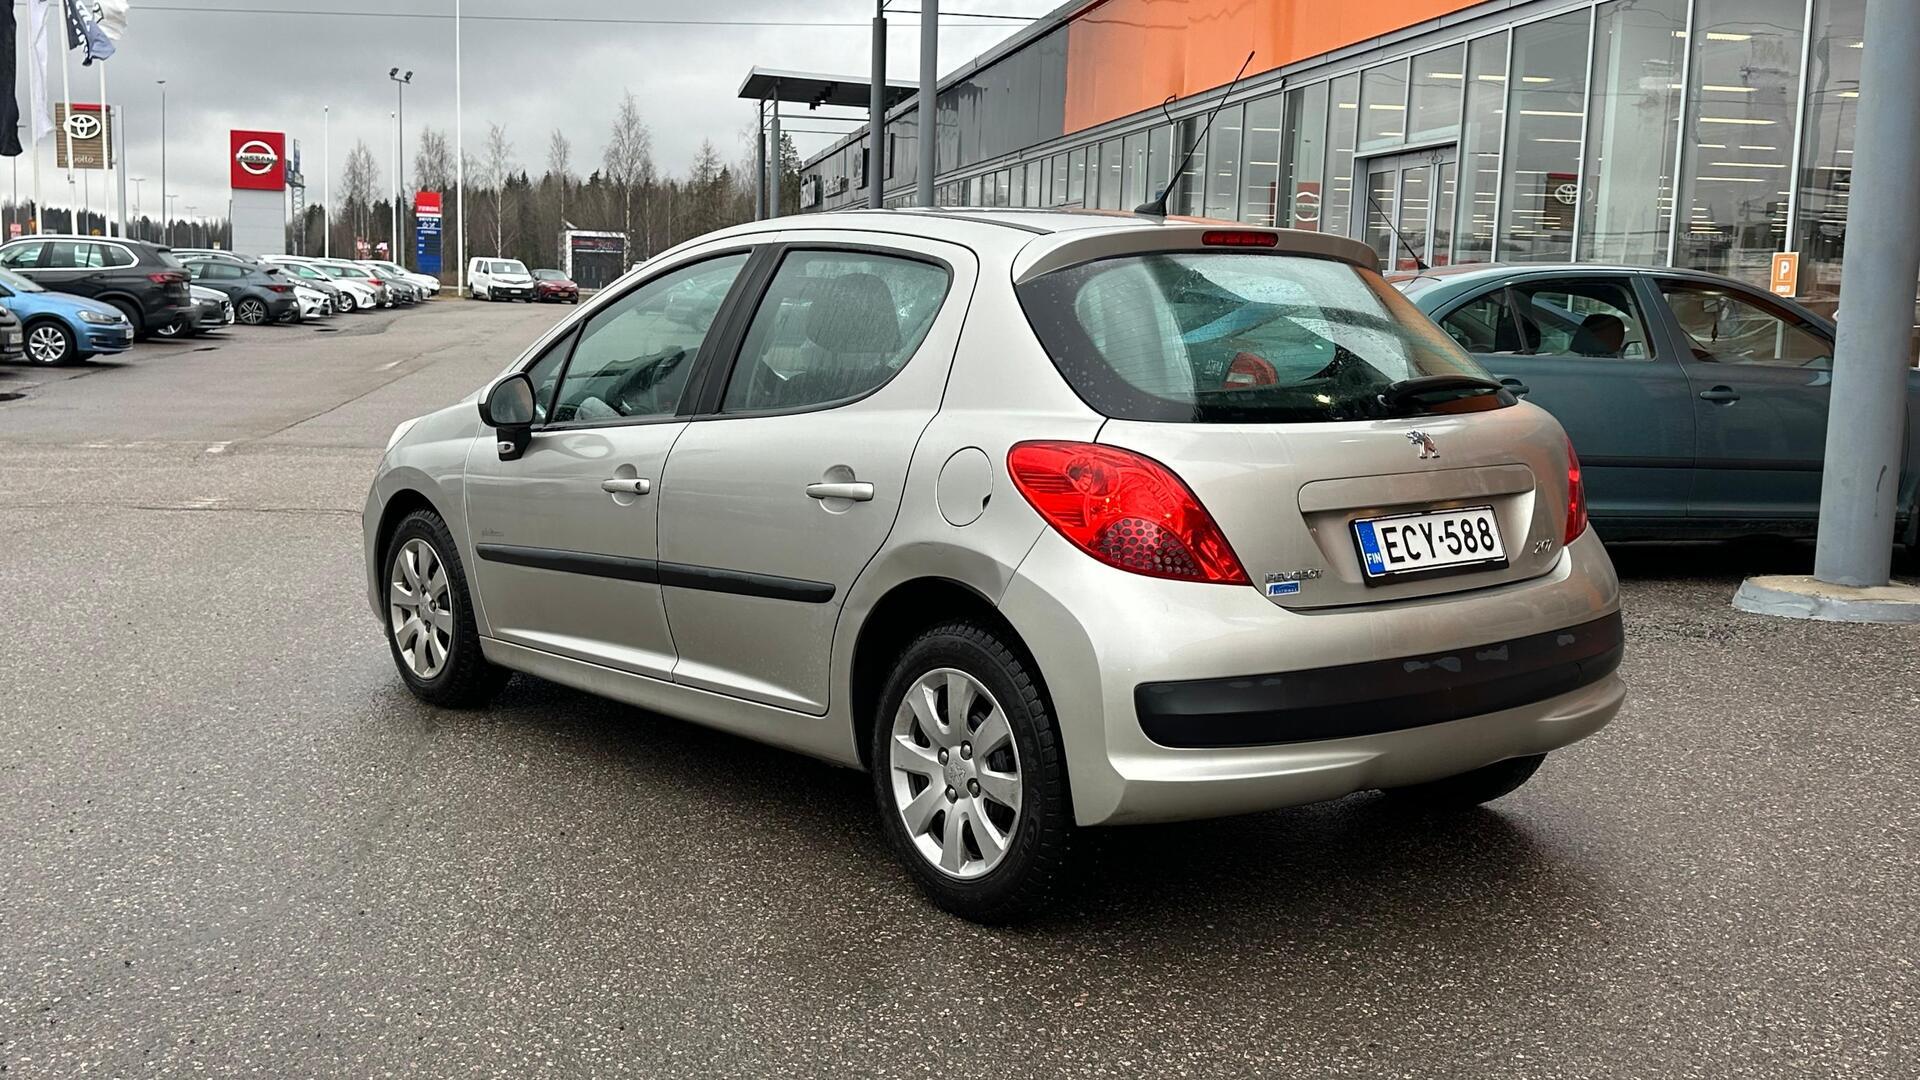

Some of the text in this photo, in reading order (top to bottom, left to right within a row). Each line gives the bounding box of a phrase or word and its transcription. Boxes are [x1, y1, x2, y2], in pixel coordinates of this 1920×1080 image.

[1780, 261, 1790, 280] P
[1381, 517, 1495, 563] ECY-588
[1366, 552, 1383, 565] FIN
[1265, 569, 1322, 583] PEUGEOT
